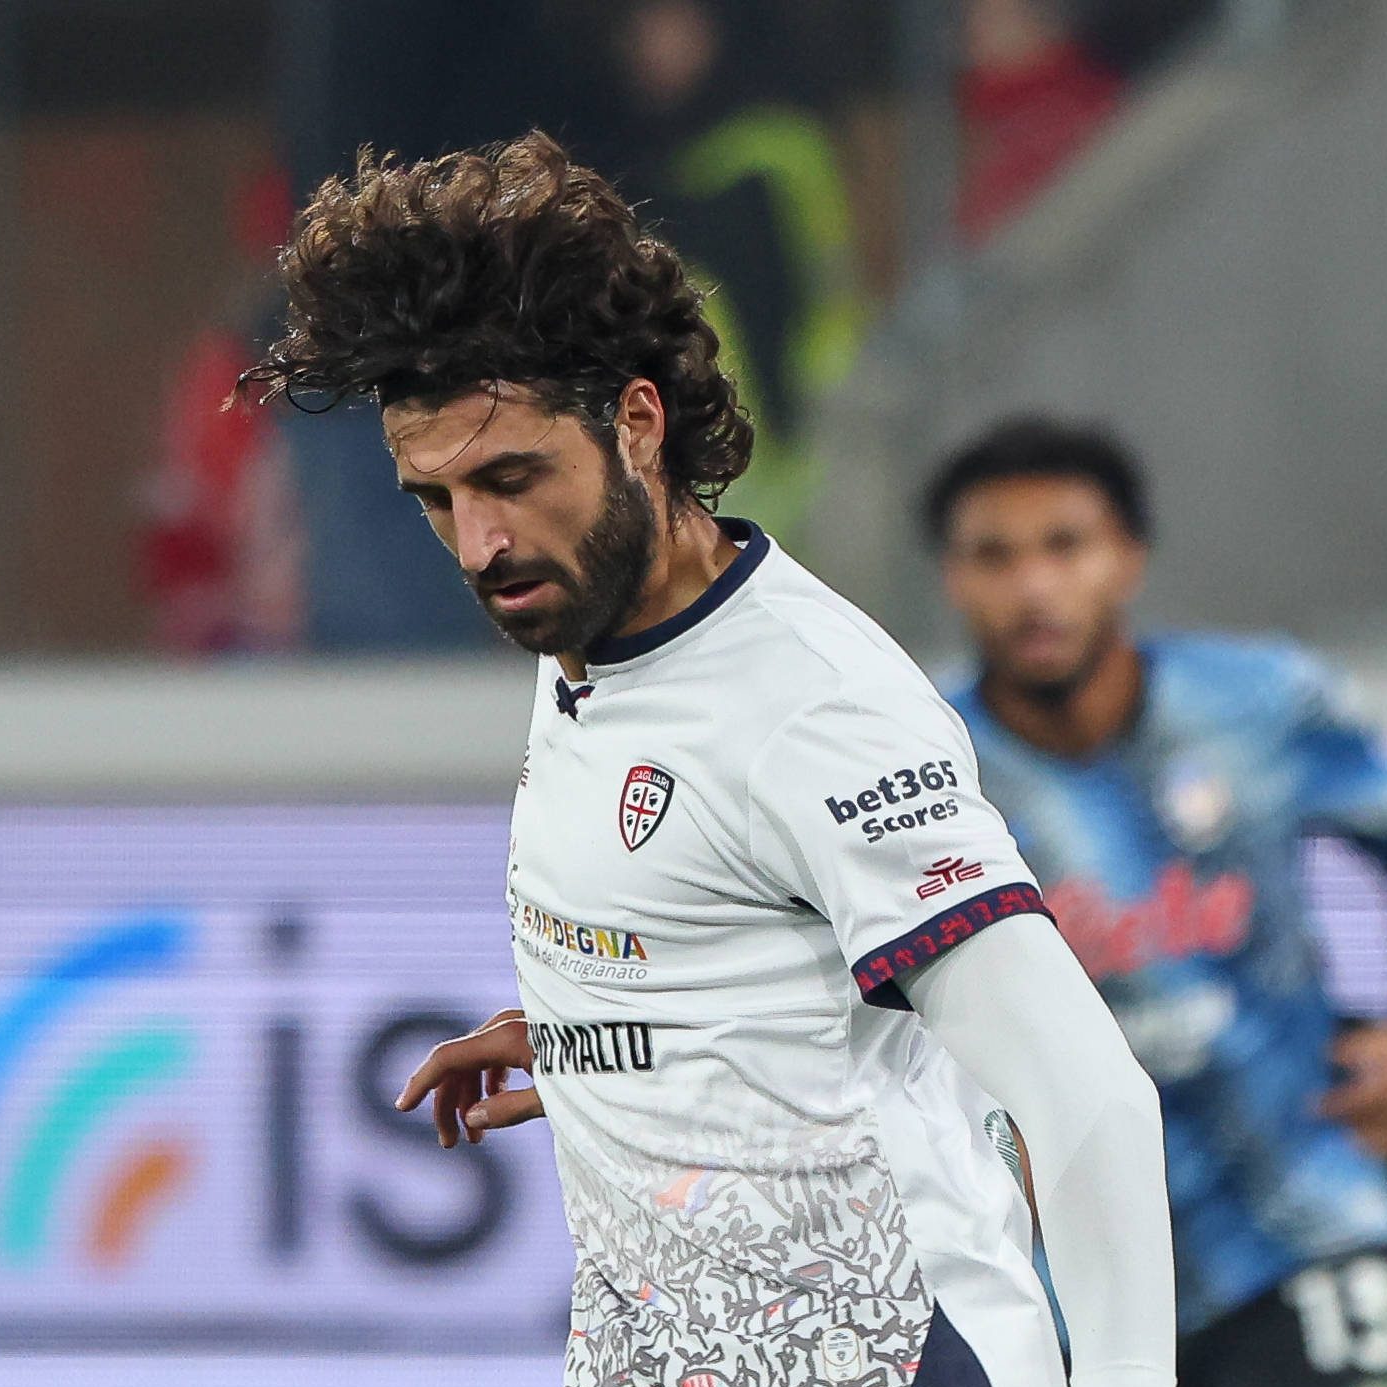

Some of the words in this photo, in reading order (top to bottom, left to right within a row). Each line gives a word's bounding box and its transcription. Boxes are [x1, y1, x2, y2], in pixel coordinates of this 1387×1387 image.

[631, 769, 670, 791] CAGLIARI
[823, 759, 958, 826] bet365
[861, 798, 959, 844] Scores
[553, 1021, 655, 1075] MALTO
